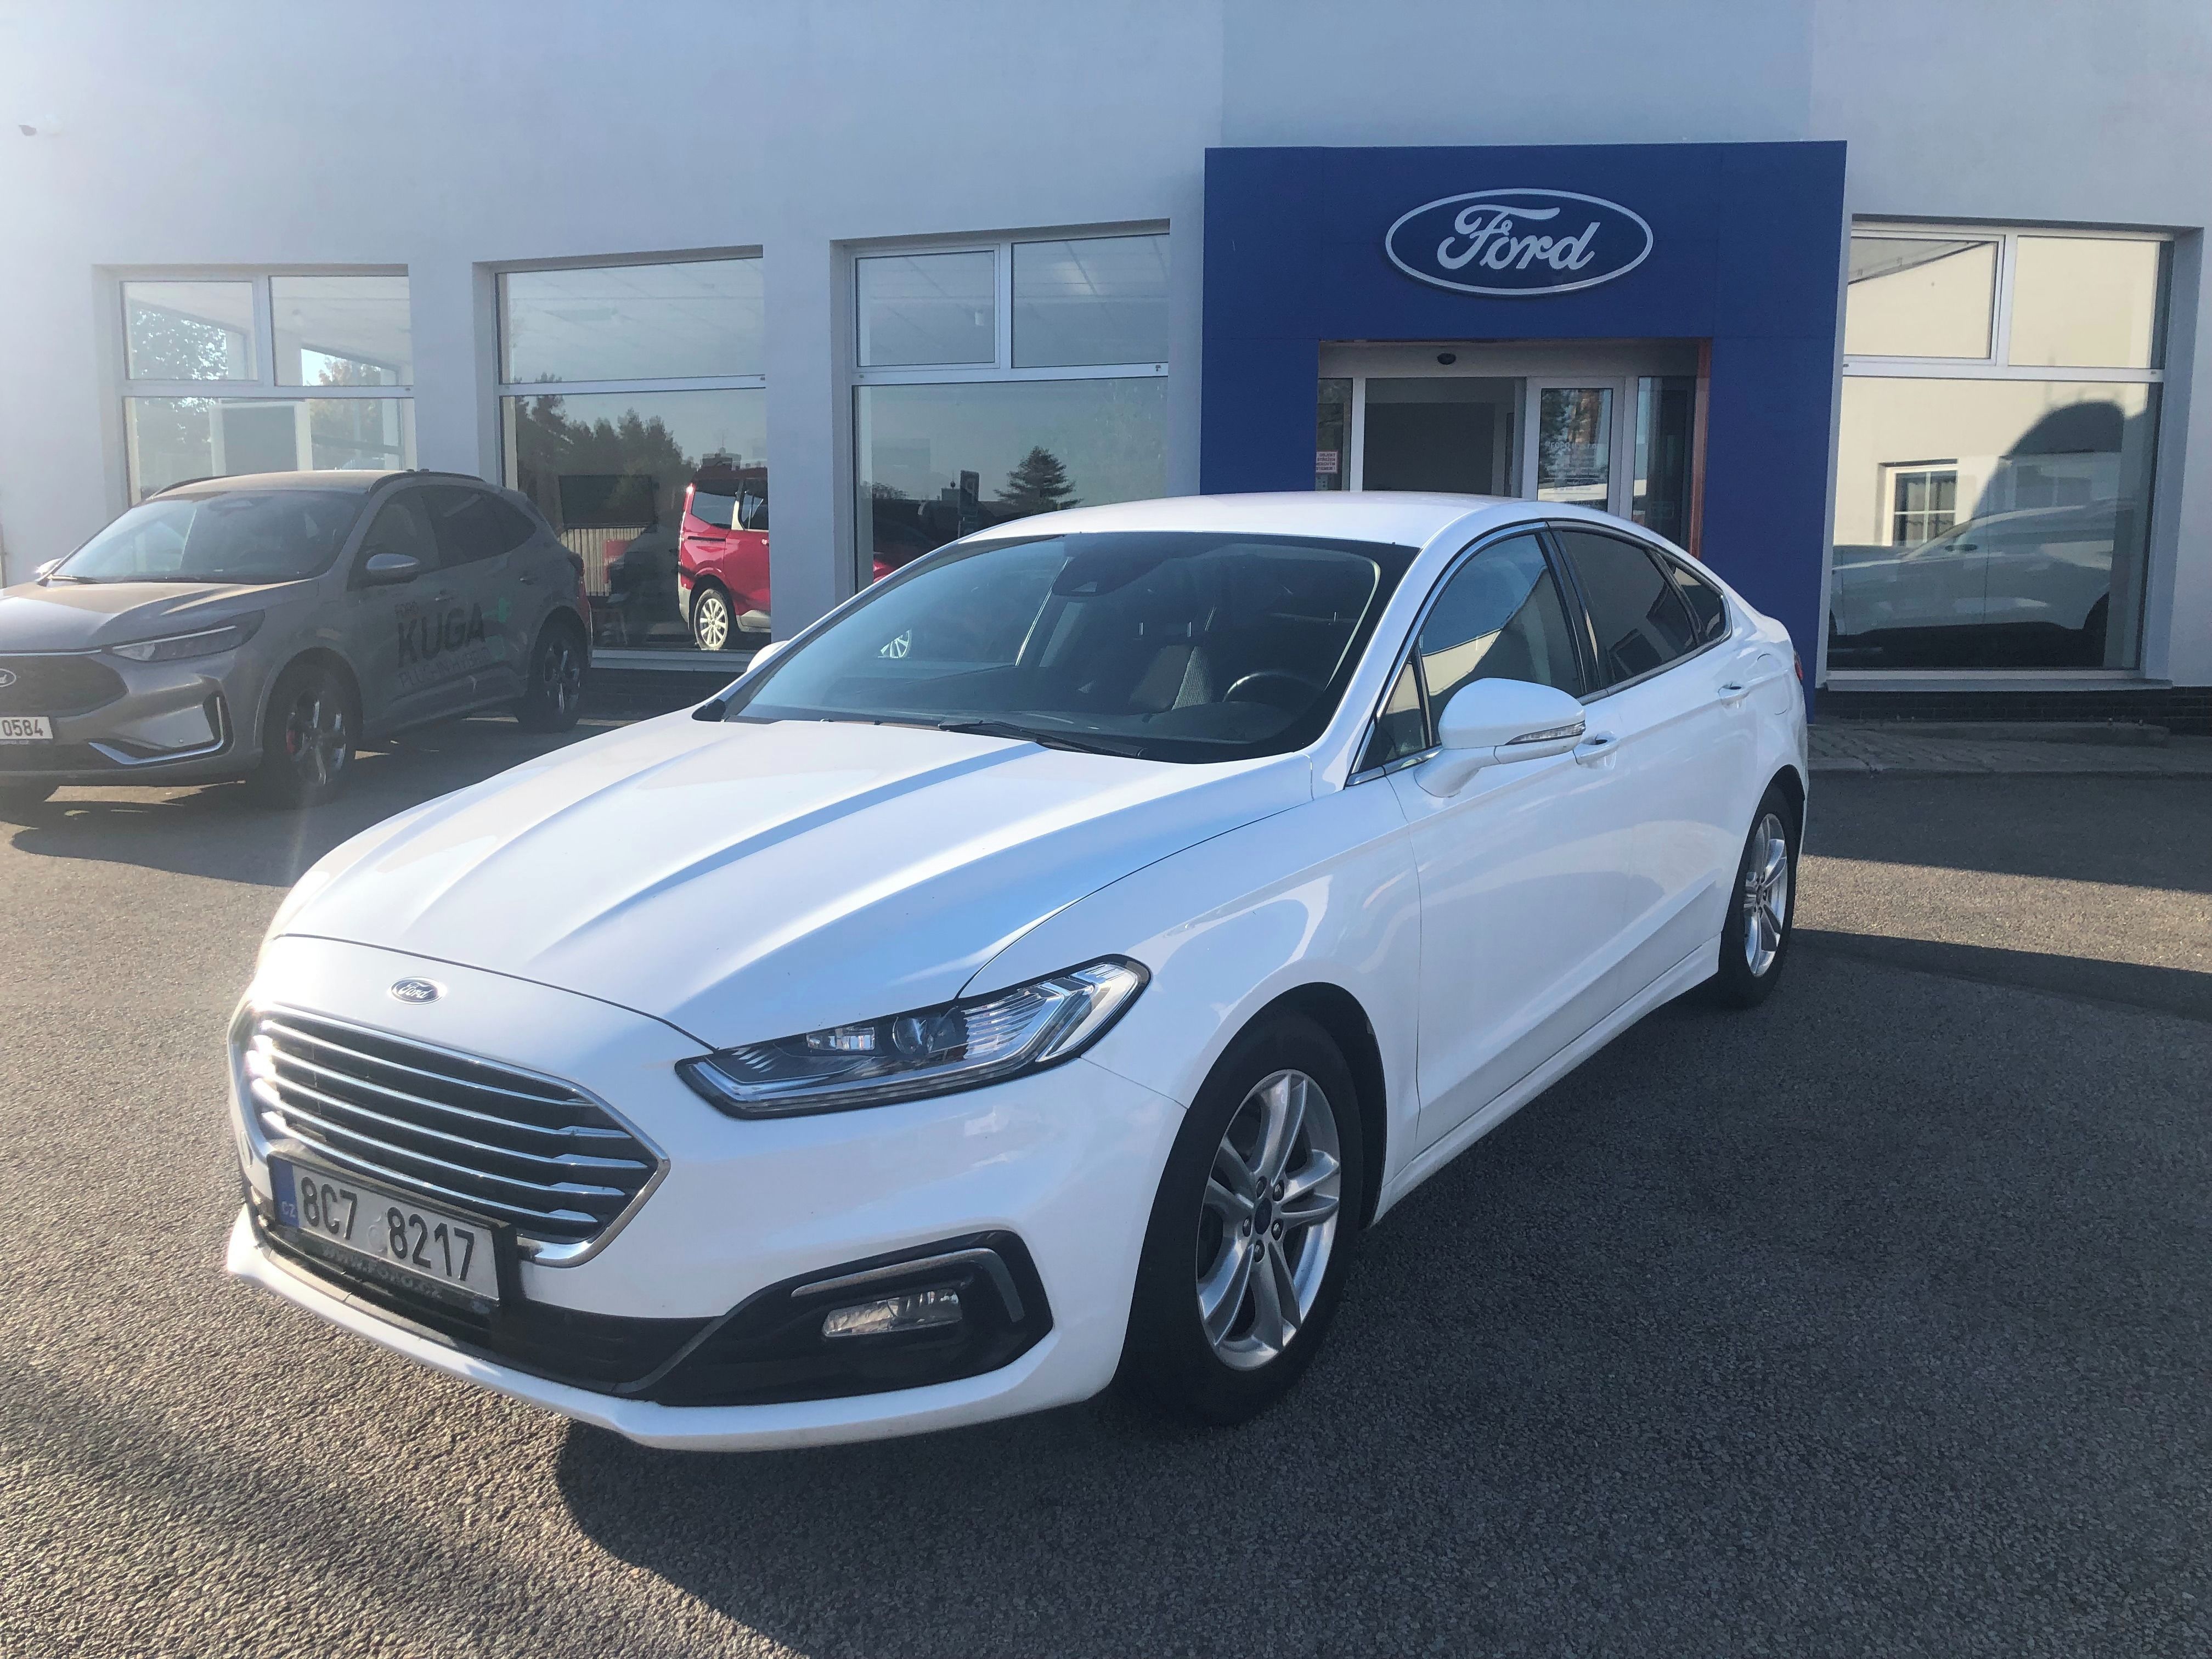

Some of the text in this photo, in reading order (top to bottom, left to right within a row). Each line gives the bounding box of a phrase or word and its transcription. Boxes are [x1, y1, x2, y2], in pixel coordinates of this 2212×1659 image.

[1437, 204, 1601, 270] Ford
[398, 603, 486, 669] KUGA
[2, 719, 43, 736] 0584
[398, 982, 433, 998] Ford
[281, 1201, 295, 1218] CZ
[301, 1176, 475, 1281] 8C7 8217
